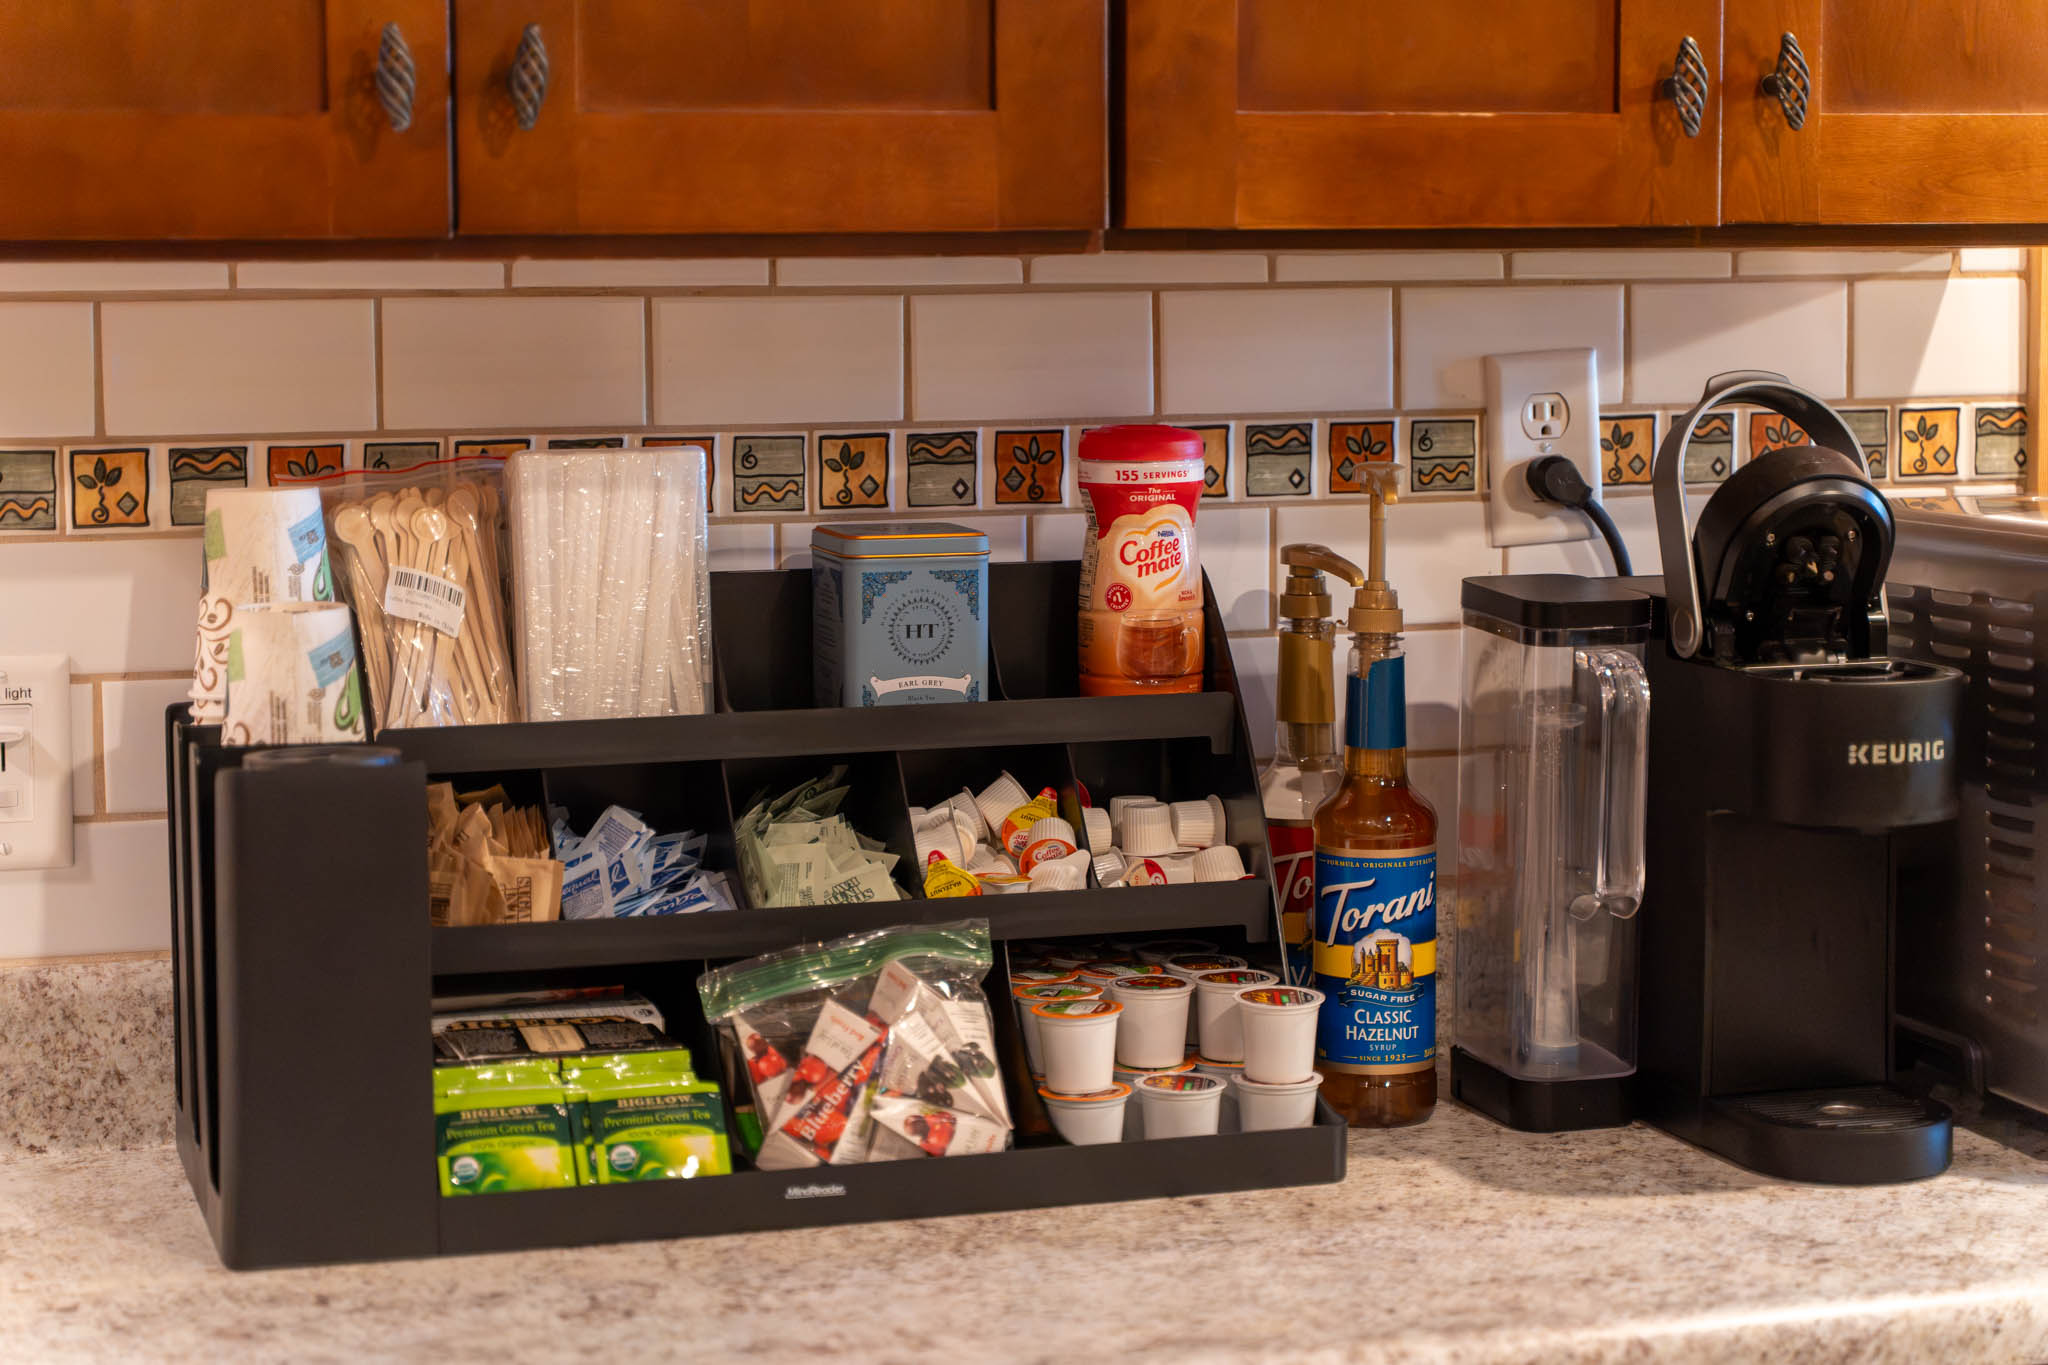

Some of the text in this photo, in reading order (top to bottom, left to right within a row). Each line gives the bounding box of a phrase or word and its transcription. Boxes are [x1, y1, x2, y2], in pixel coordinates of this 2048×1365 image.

[1116, 470, 1139, 481] 155
[1129, 493, 1177, 502] ORIGINAL
[1119, 538, 1180, 566] Coffee
[1137, 551, 1182, 578] mate
[905, 623, 940, 639] HT
[898, 679, 944, 689] EARL GREY
[5, 687, 32, 701] light
[1848, 740, 1945, 765] KEURIG
[930, 879, 962, 897] HAZELNUT
[1321, 870, 1435, 947] Torani
[1350, 989, 1415, 1003] SUGAR FREE
[1354, 1009, 1412, 1024] CLASSIC
[1345, 1025, 1419, 1041] HAZELNUT
[1369, 1044, 1397, 1052] SYRUP
[1385, 1053, 1407, 1062] 1925
[617, 1094, 693, 1107] BIGELOW
[799, 1058, 868, 1142] Blueberry
[461, 1105, 537, 1119] BIGELOW
[603, 1109, 711, 1128] Premium Green Tea
[446, 1120, 556, 1139] Premium Green Tea
